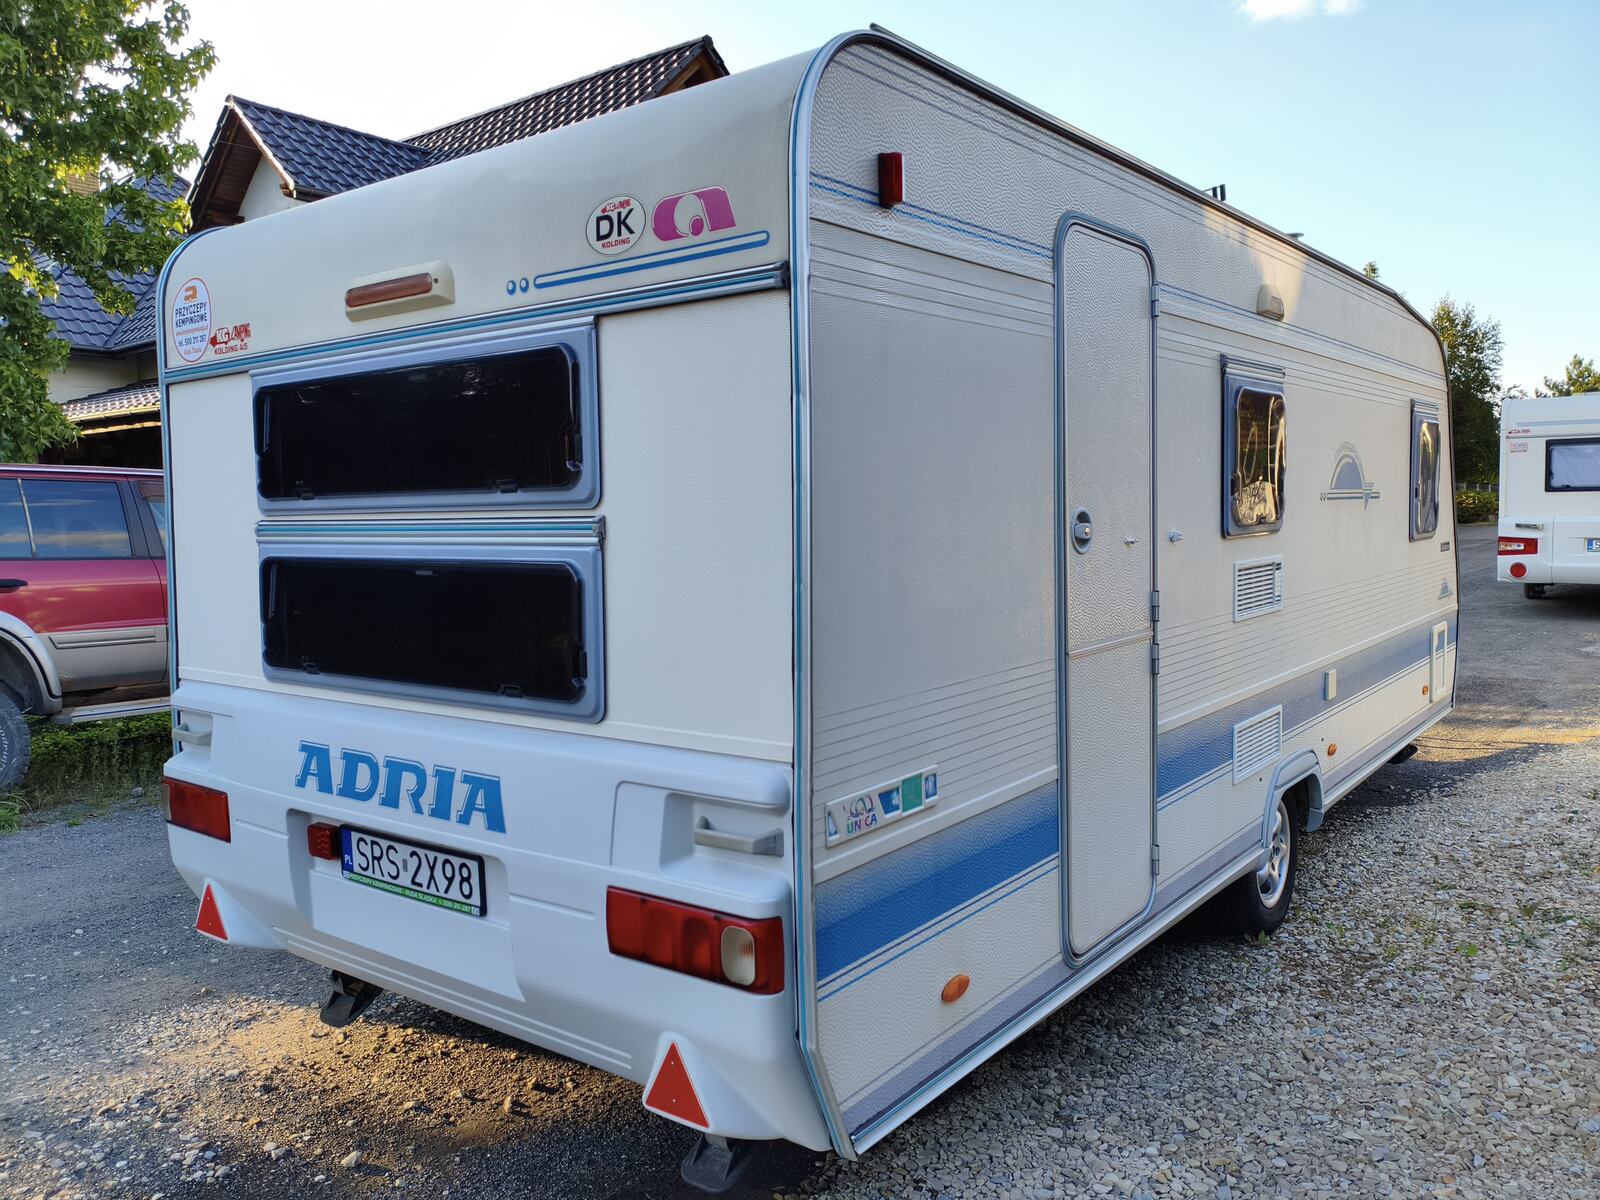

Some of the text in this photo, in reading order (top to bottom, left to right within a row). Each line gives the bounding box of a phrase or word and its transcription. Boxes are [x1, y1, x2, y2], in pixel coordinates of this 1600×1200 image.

[596, 208, 635, 242] DK
[601, 237, 631, 249] KOLDING
[175, 301, 208, 318] PRZYCZEPY
[175, 312, 208, 328] KEMPINGOWE
[216, 327, 230, 343] KG
[214, 345, 238, 355] KOLDING
[295, 740, 506, 833] ADRIA
[847, 813, 877, 834] UNICA
[344, 854, 353, 866] PL
[356, 837, 474, 900] SRS 2X98
